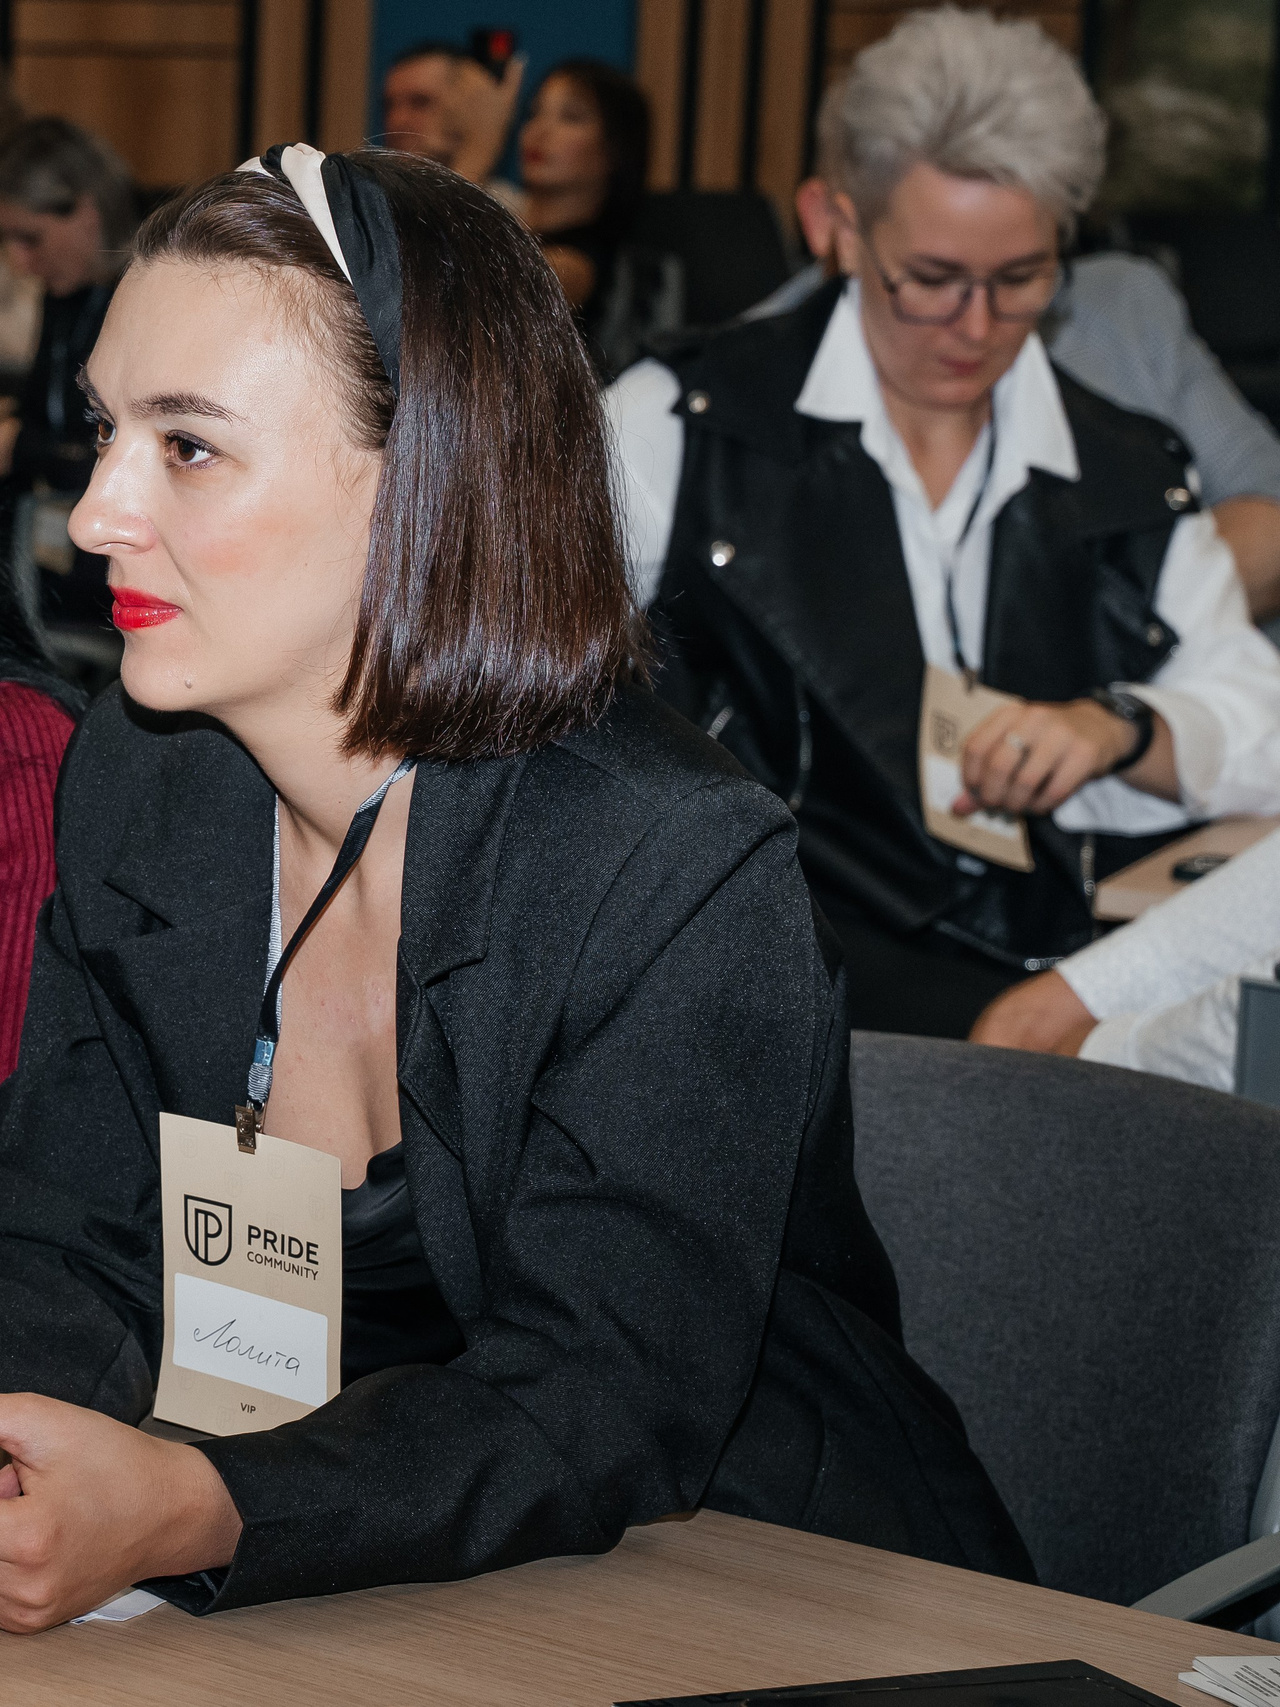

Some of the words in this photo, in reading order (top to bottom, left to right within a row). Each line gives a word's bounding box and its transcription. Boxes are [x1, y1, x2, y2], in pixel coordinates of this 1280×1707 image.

[247, 1224, 319, 1265] PRIDE
[247, 1251, 319, 1281] COMMUNITY
[193, 1318, 301, 1377] Лолита
[239, 1402, 257, 1415] VIP
